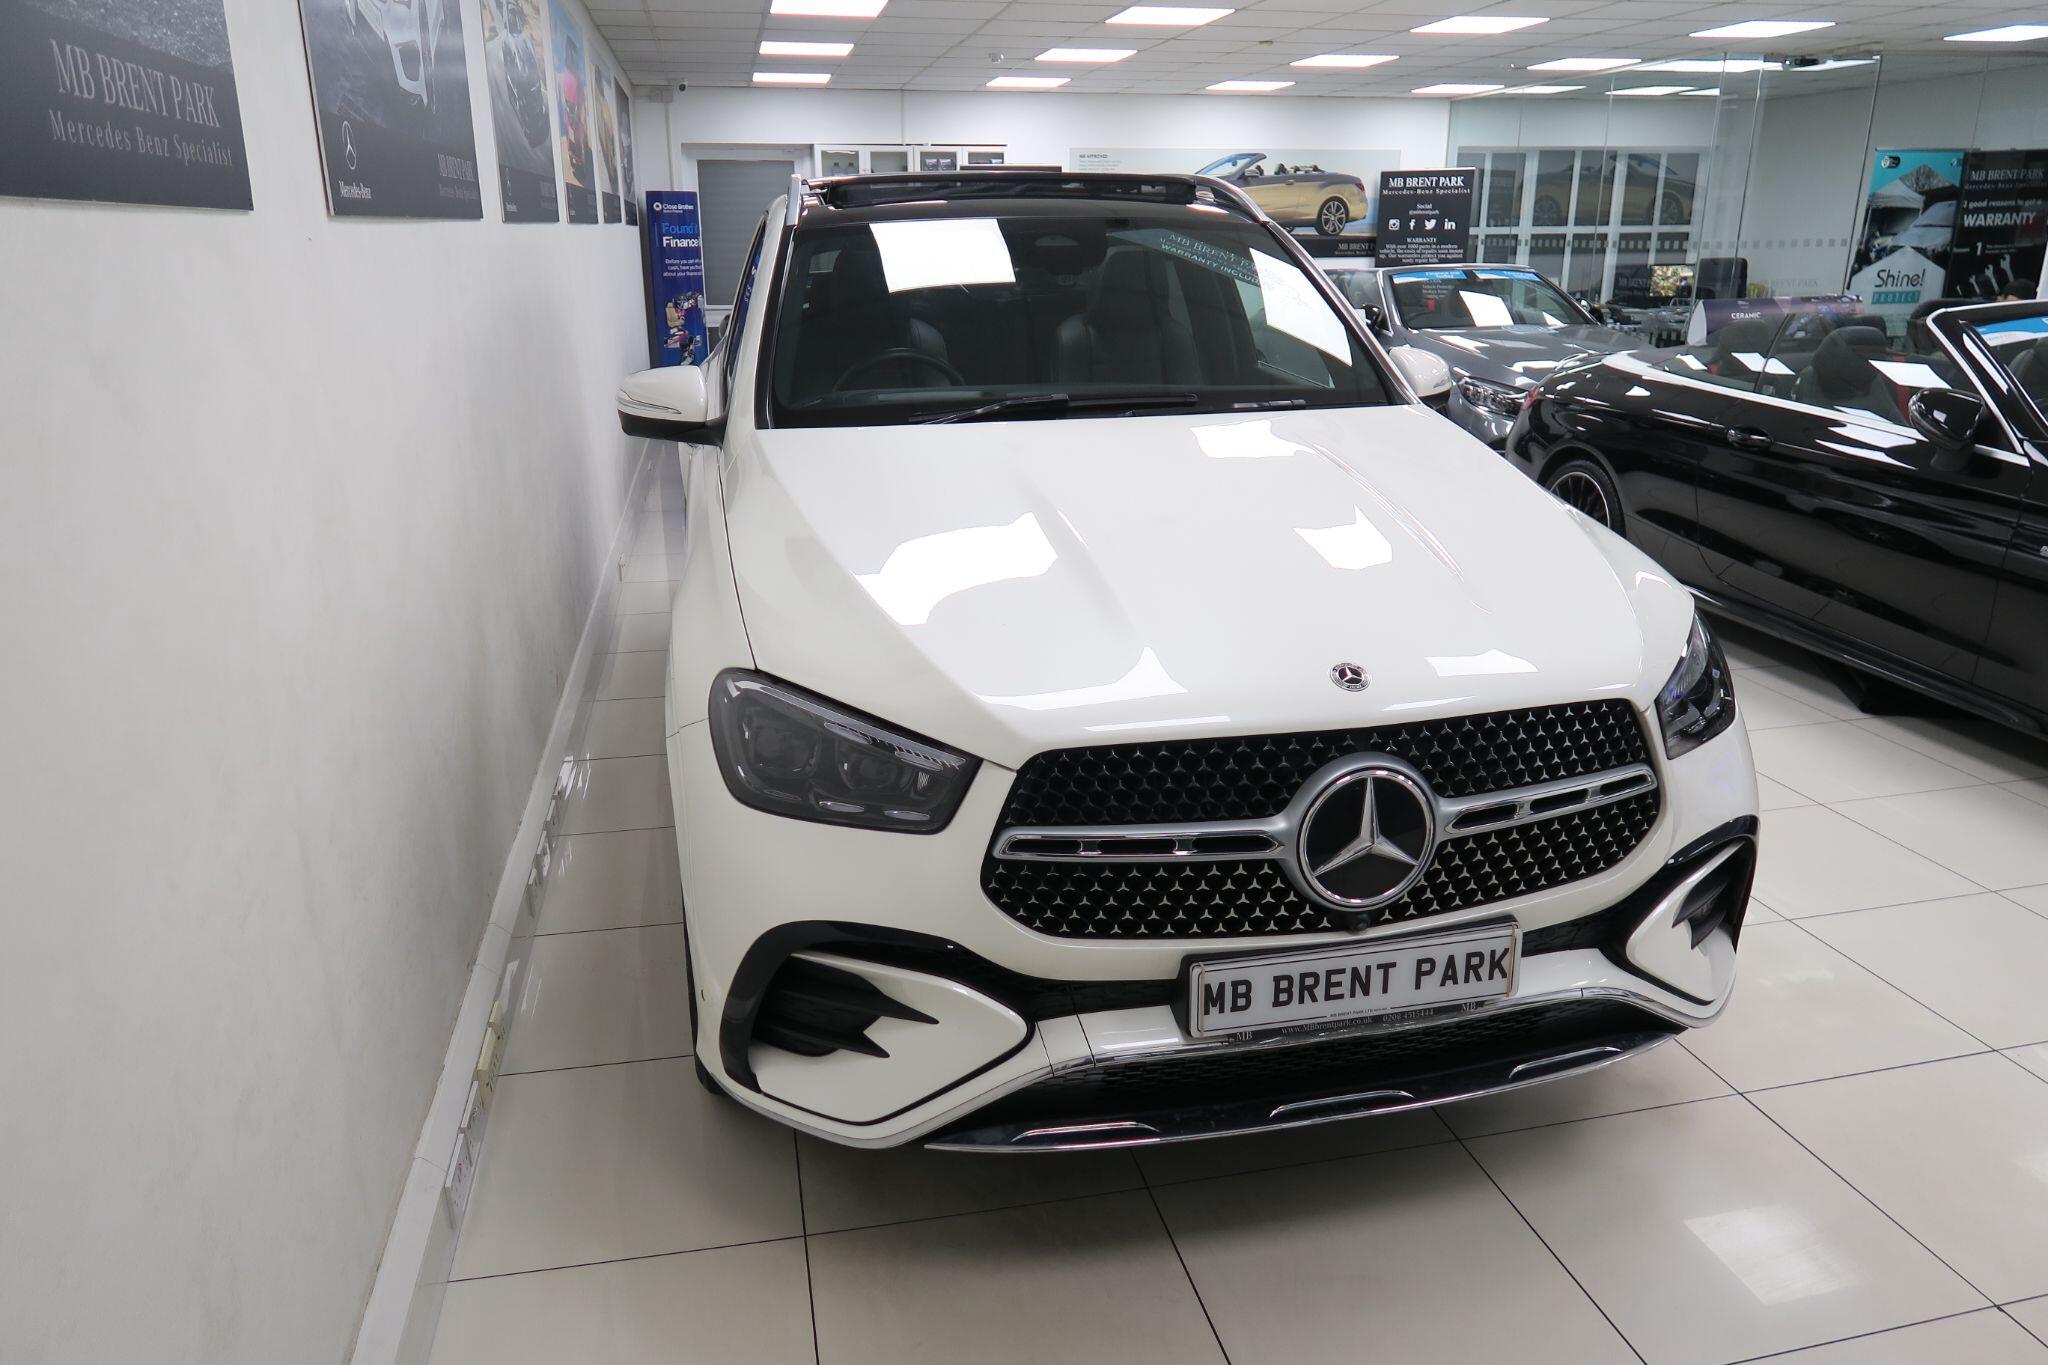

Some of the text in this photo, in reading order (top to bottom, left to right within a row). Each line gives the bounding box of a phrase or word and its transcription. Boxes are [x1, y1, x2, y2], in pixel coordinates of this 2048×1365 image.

[50, 39, 221, 128] MB BRENT PARK
[49, 109, 233, 168] Mercedes Benz Specialist
[1389, 176, 1465, 188] MB BRENT PARK
[1970, 168, 2045, 181] MB BRENT PARK
[1968, 199, 1988, 209] good
[1963, 212, 2037, 228] WARRANTY
[1161, 243, 1219, 269] WARRANTY
[1874, 269, 1926, 288] Shine!
[1731, 311, 1761, 320] CERAMIC
[1203, 946, 1510, 1016] MB BRENT PARK
[1462, 1001, 1478, 1013] MB
[1280, 1015, 1374, 1034] www.MBbrentpark.co.uk
[1236, 1030, 1254, 1042] MB
